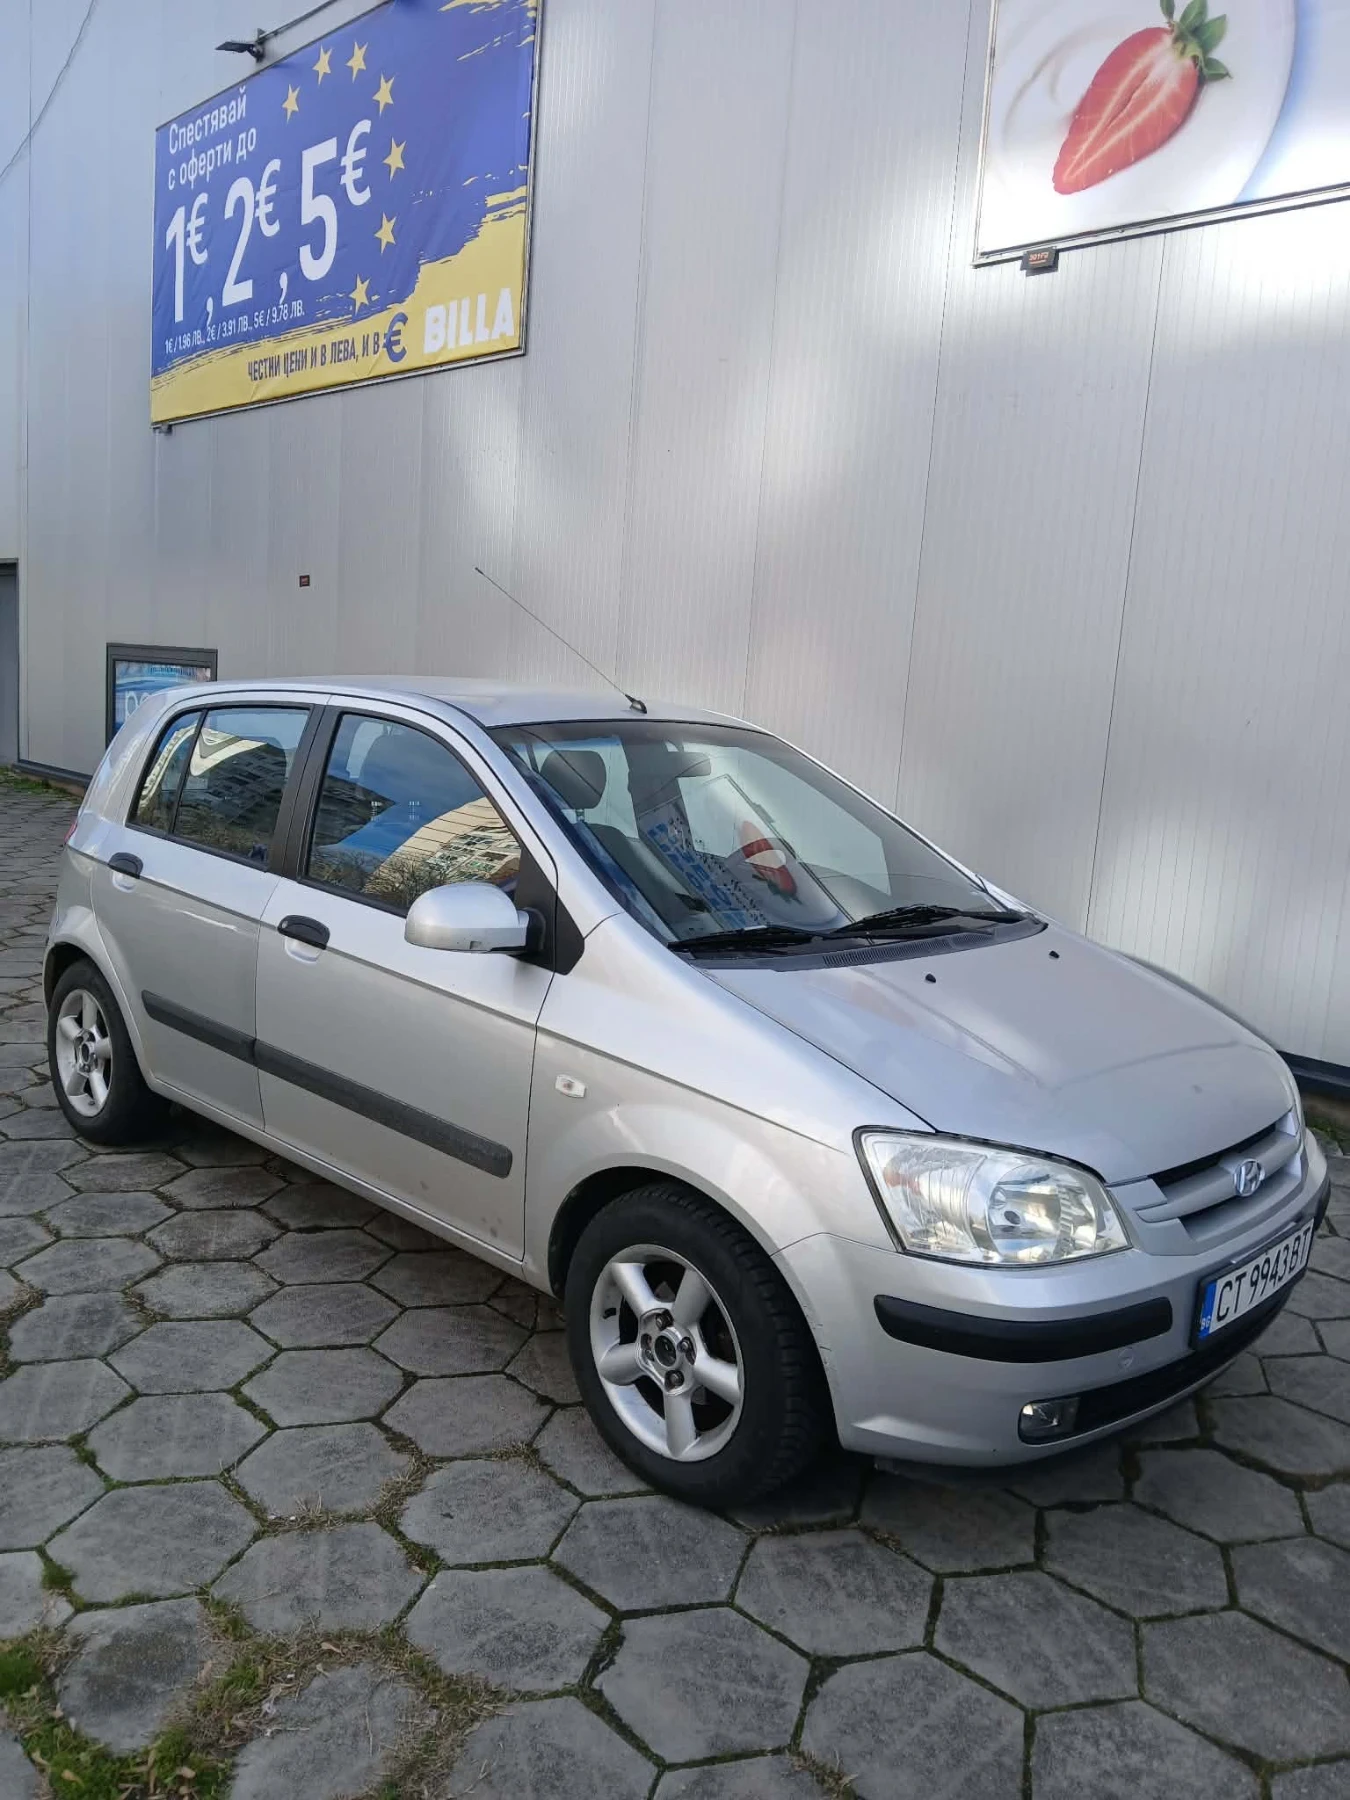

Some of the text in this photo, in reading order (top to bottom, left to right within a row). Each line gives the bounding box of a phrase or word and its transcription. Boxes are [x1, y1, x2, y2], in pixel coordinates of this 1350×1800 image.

[169, 85, 247, 154] Спестявай
[168, 127, 257, 190] с оферти до
[299, 118, 372, 282] 5€
[248, 312, 409, 381] ЧЕСТНИ ЦЕНИ И В ЛЕВА, И В €
[424, 288, 515, 354] BILLA
